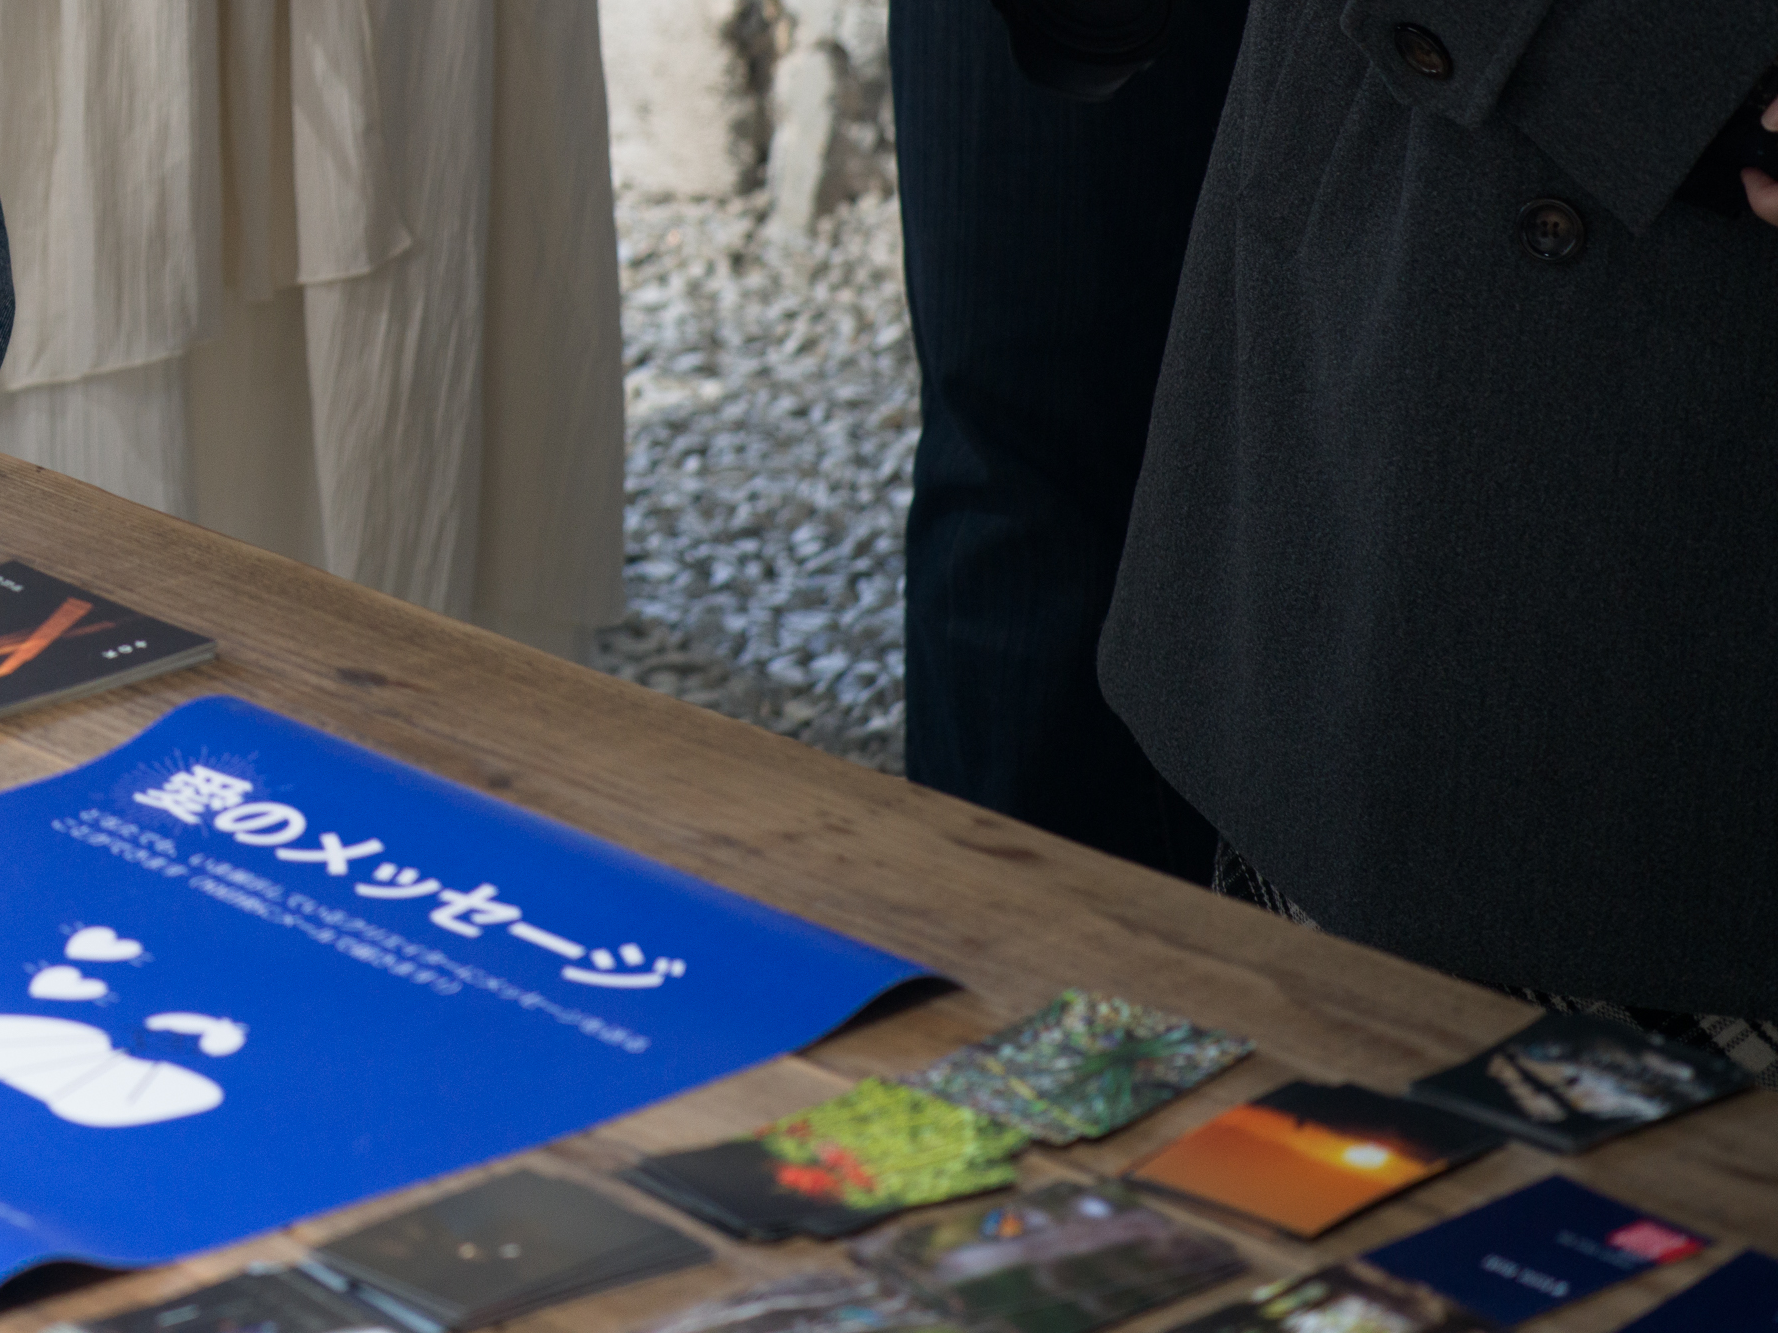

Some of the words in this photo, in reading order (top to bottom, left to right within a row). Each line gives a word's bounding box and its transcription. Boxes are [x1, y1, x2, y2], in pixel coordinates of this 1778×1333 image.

[132, 765, 687, 988] 愛のメッセージ
